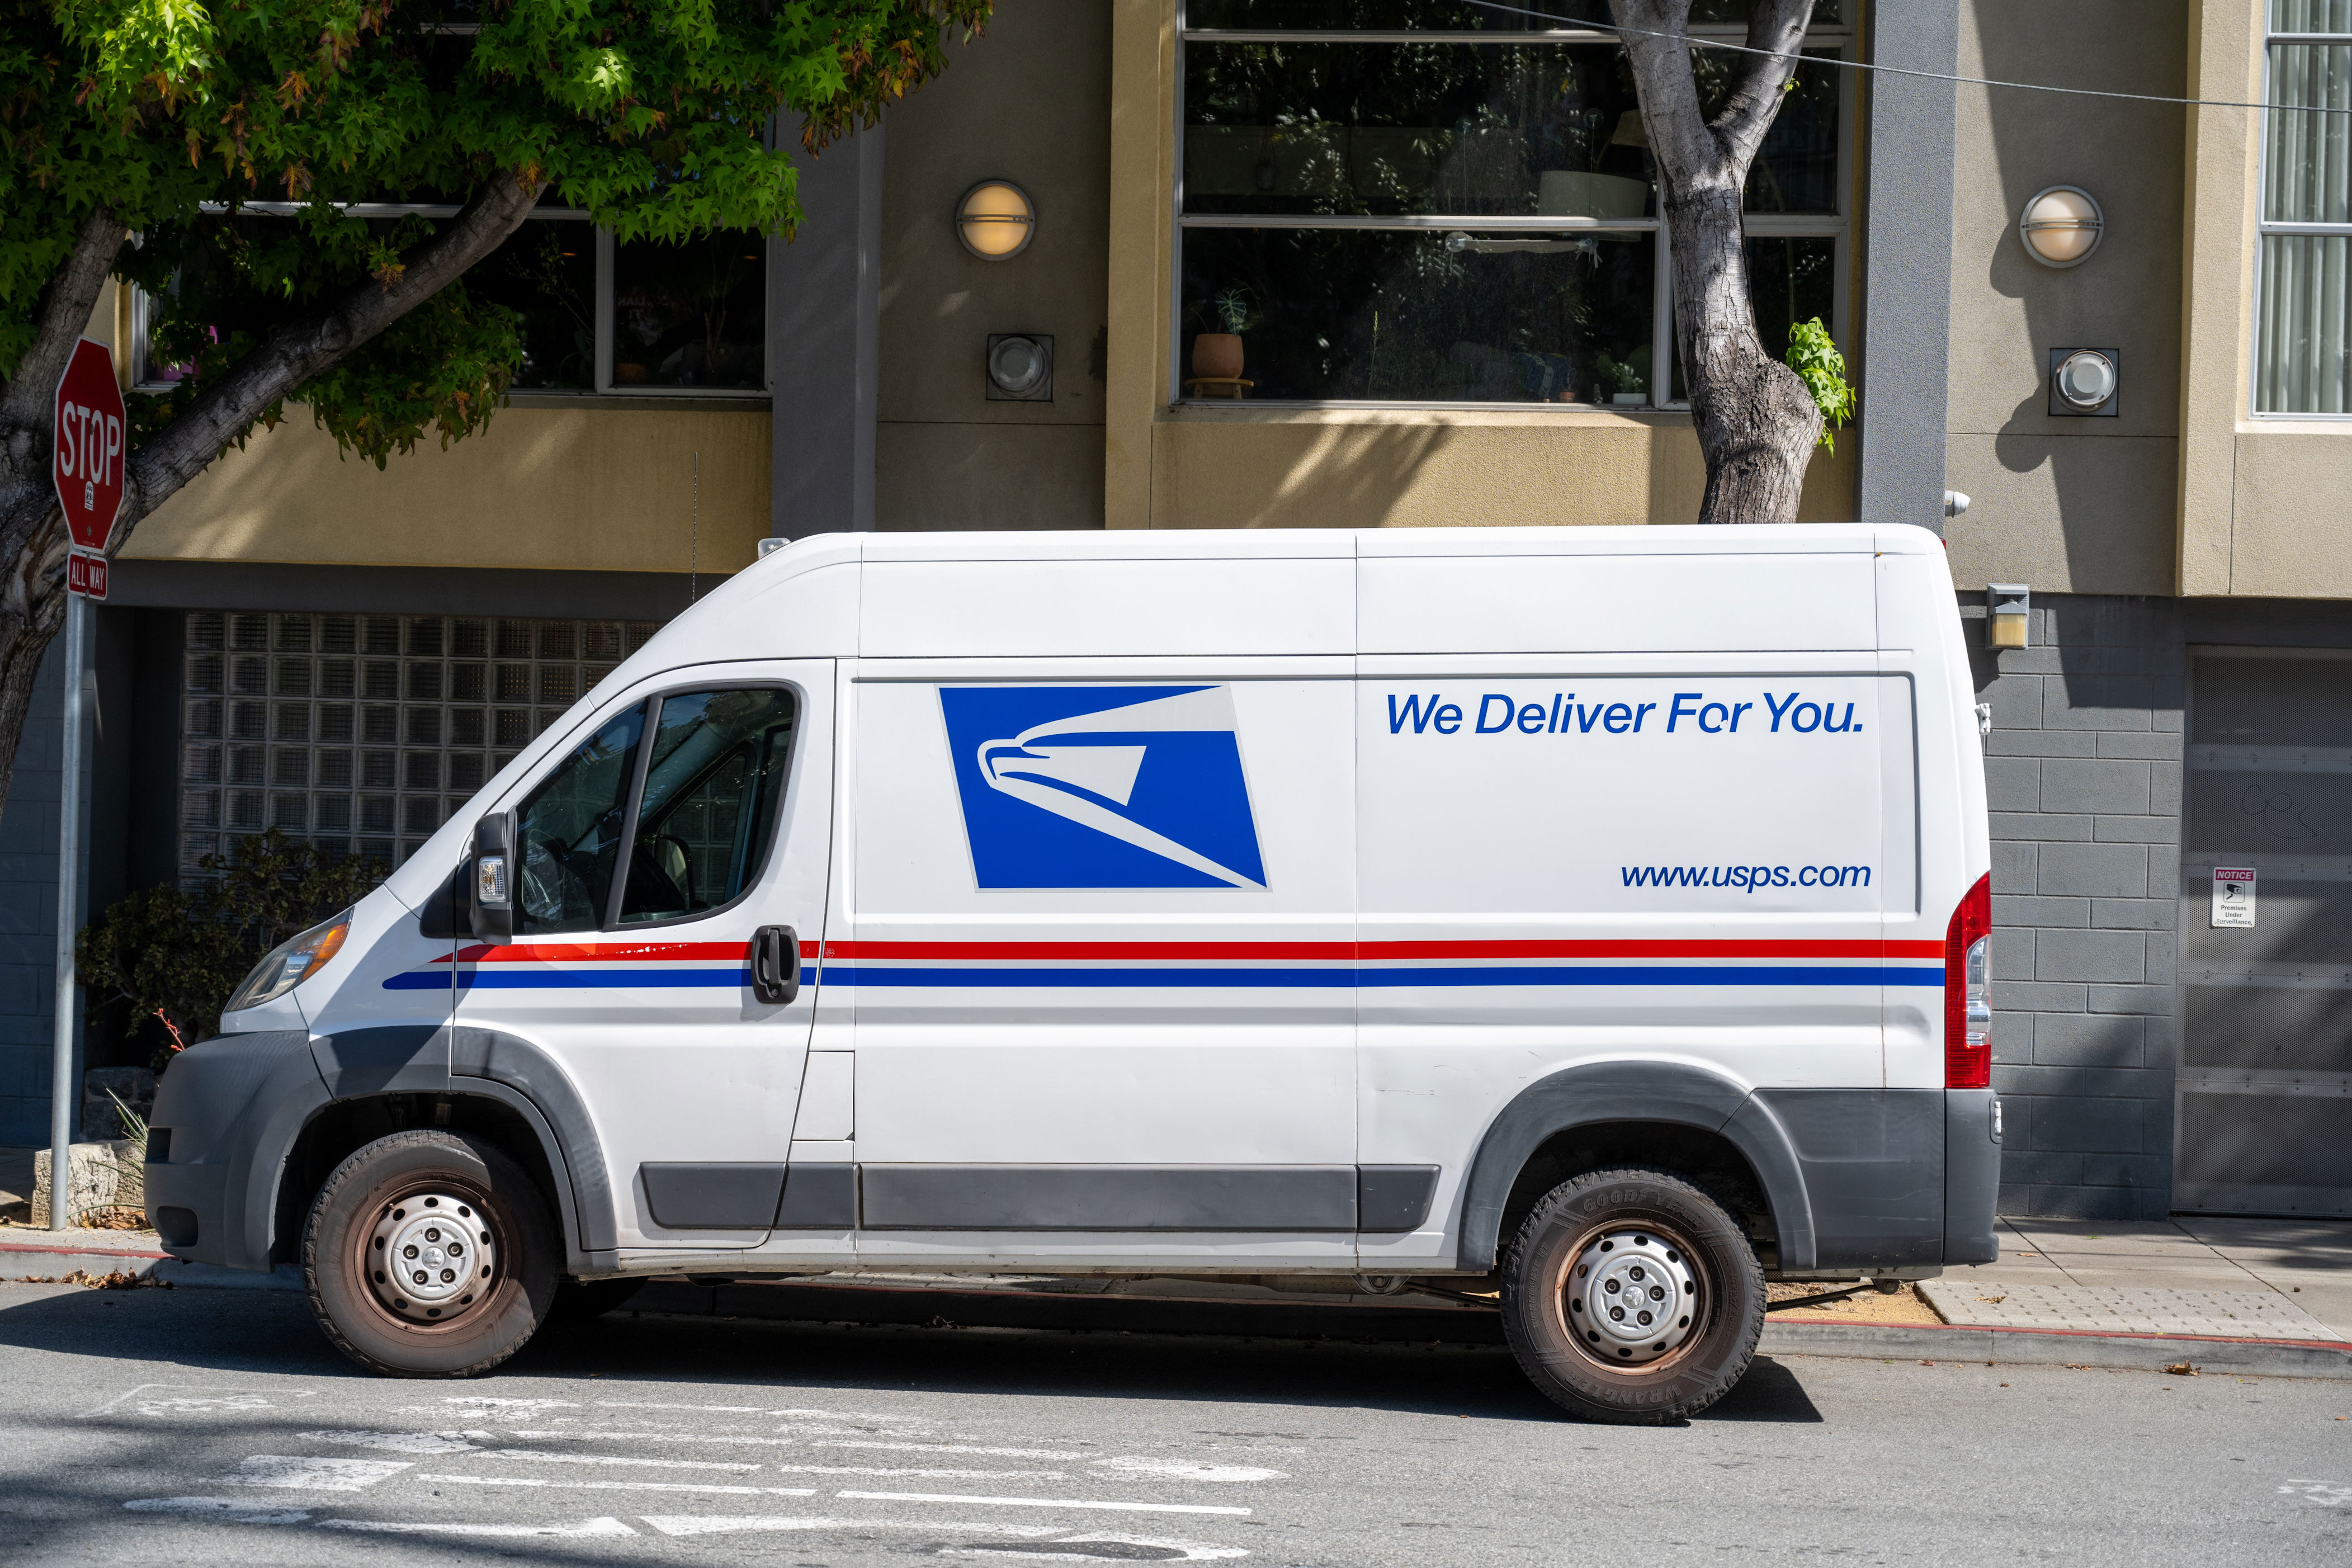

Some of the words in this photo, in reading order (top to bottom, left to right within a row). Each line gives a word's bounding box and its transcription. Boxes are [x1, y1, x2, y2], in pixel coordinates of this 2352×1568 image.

[60, 400, 120, 487] STOP
[71, 561, 86, 587] ALL
[89, 565, 105, 591] WAY
[1388, 695, 1462, 734] We
[1476, 693, 1656, 734] Deliver
[1667, 693, 1753, 733] For
[1764, 693, 1862, 733] You.
[1622, 866, 1871, 894] www.usps.com
[2217, 871, 2252, 880] NOTICE
[1528, 1260, 1541, 1329] WORKHORSE
[1565, 1371, 1683, 1405] WRANGLER
